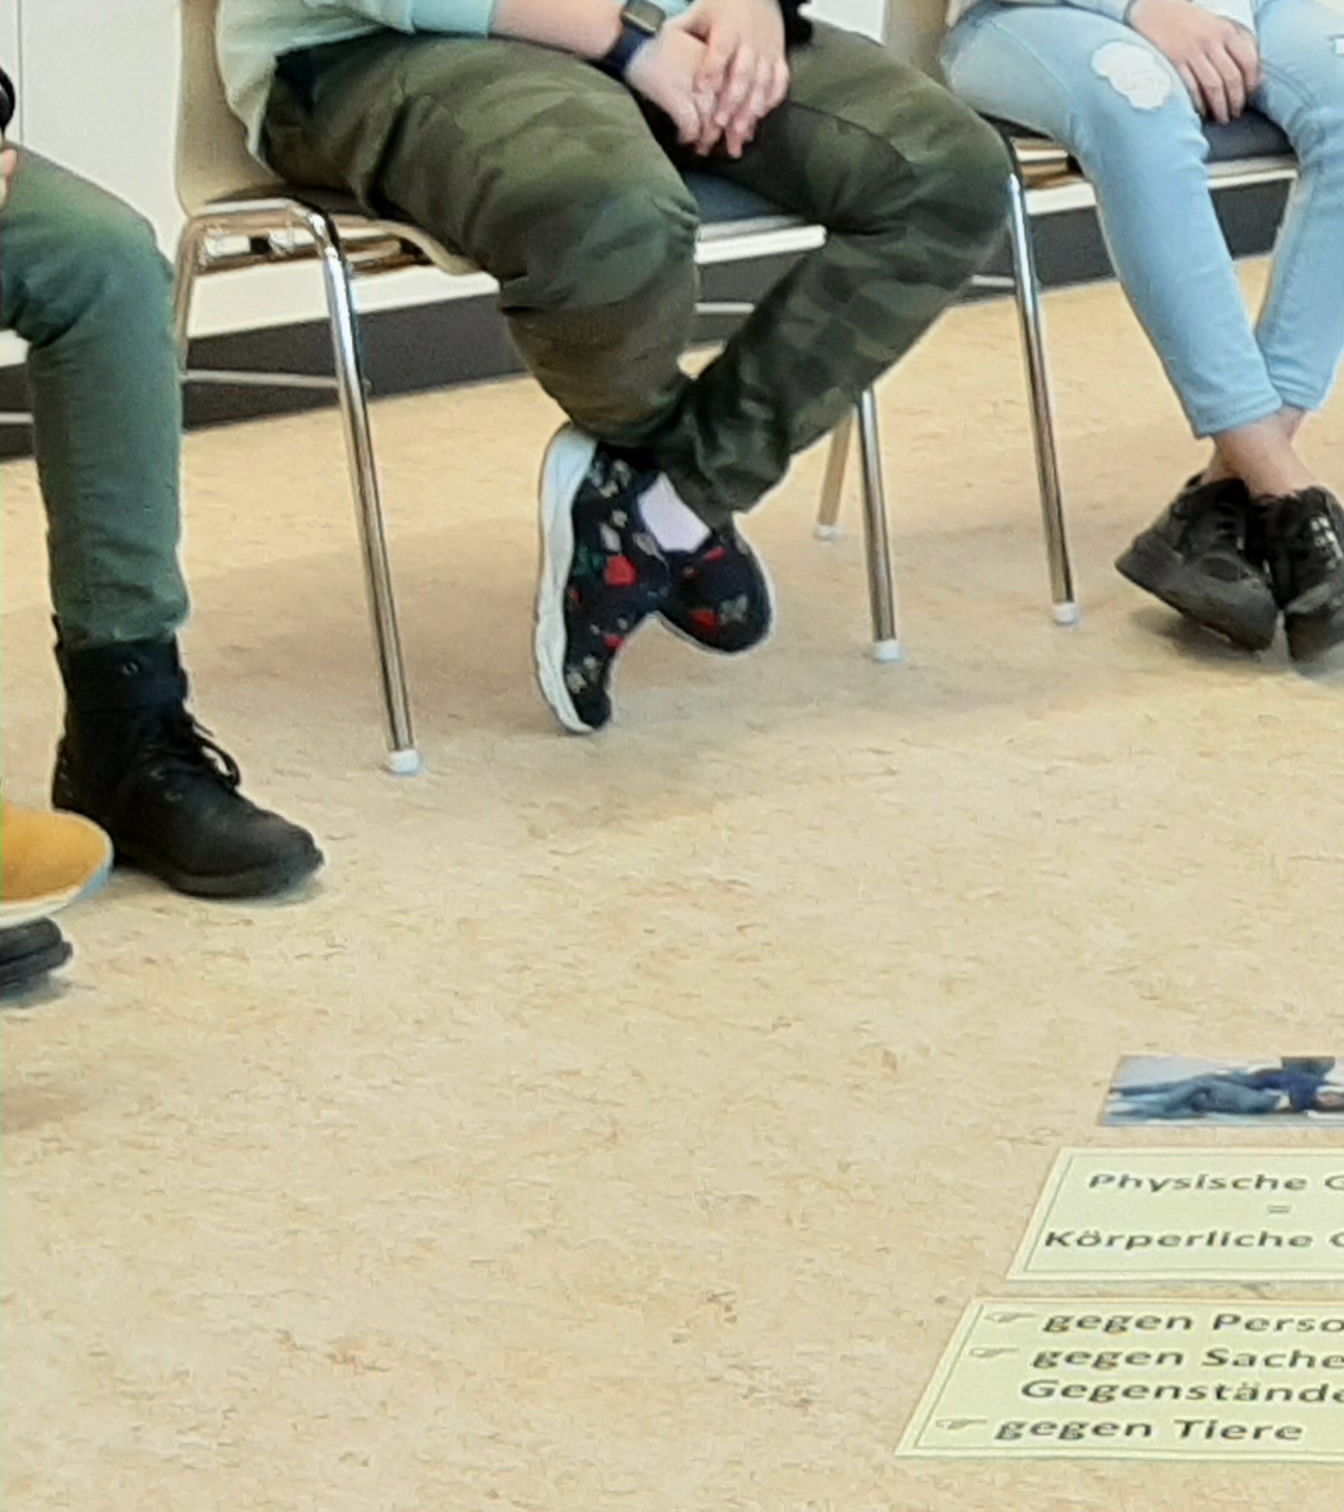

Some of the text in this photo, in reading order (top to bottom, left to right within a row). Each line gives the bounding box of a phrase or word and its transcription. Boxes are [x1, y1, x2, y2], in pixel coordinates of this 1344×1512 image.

[1088, 1172, 1308, 1193] Physische
[1044, 1229, 1314, 1251] Körperliche
[1041, 1313, 1194, 1335] gegen
[1030, 1348, 1185, 1370] gegen
[994, 1419, 1305, 1442] gegen Tiere
